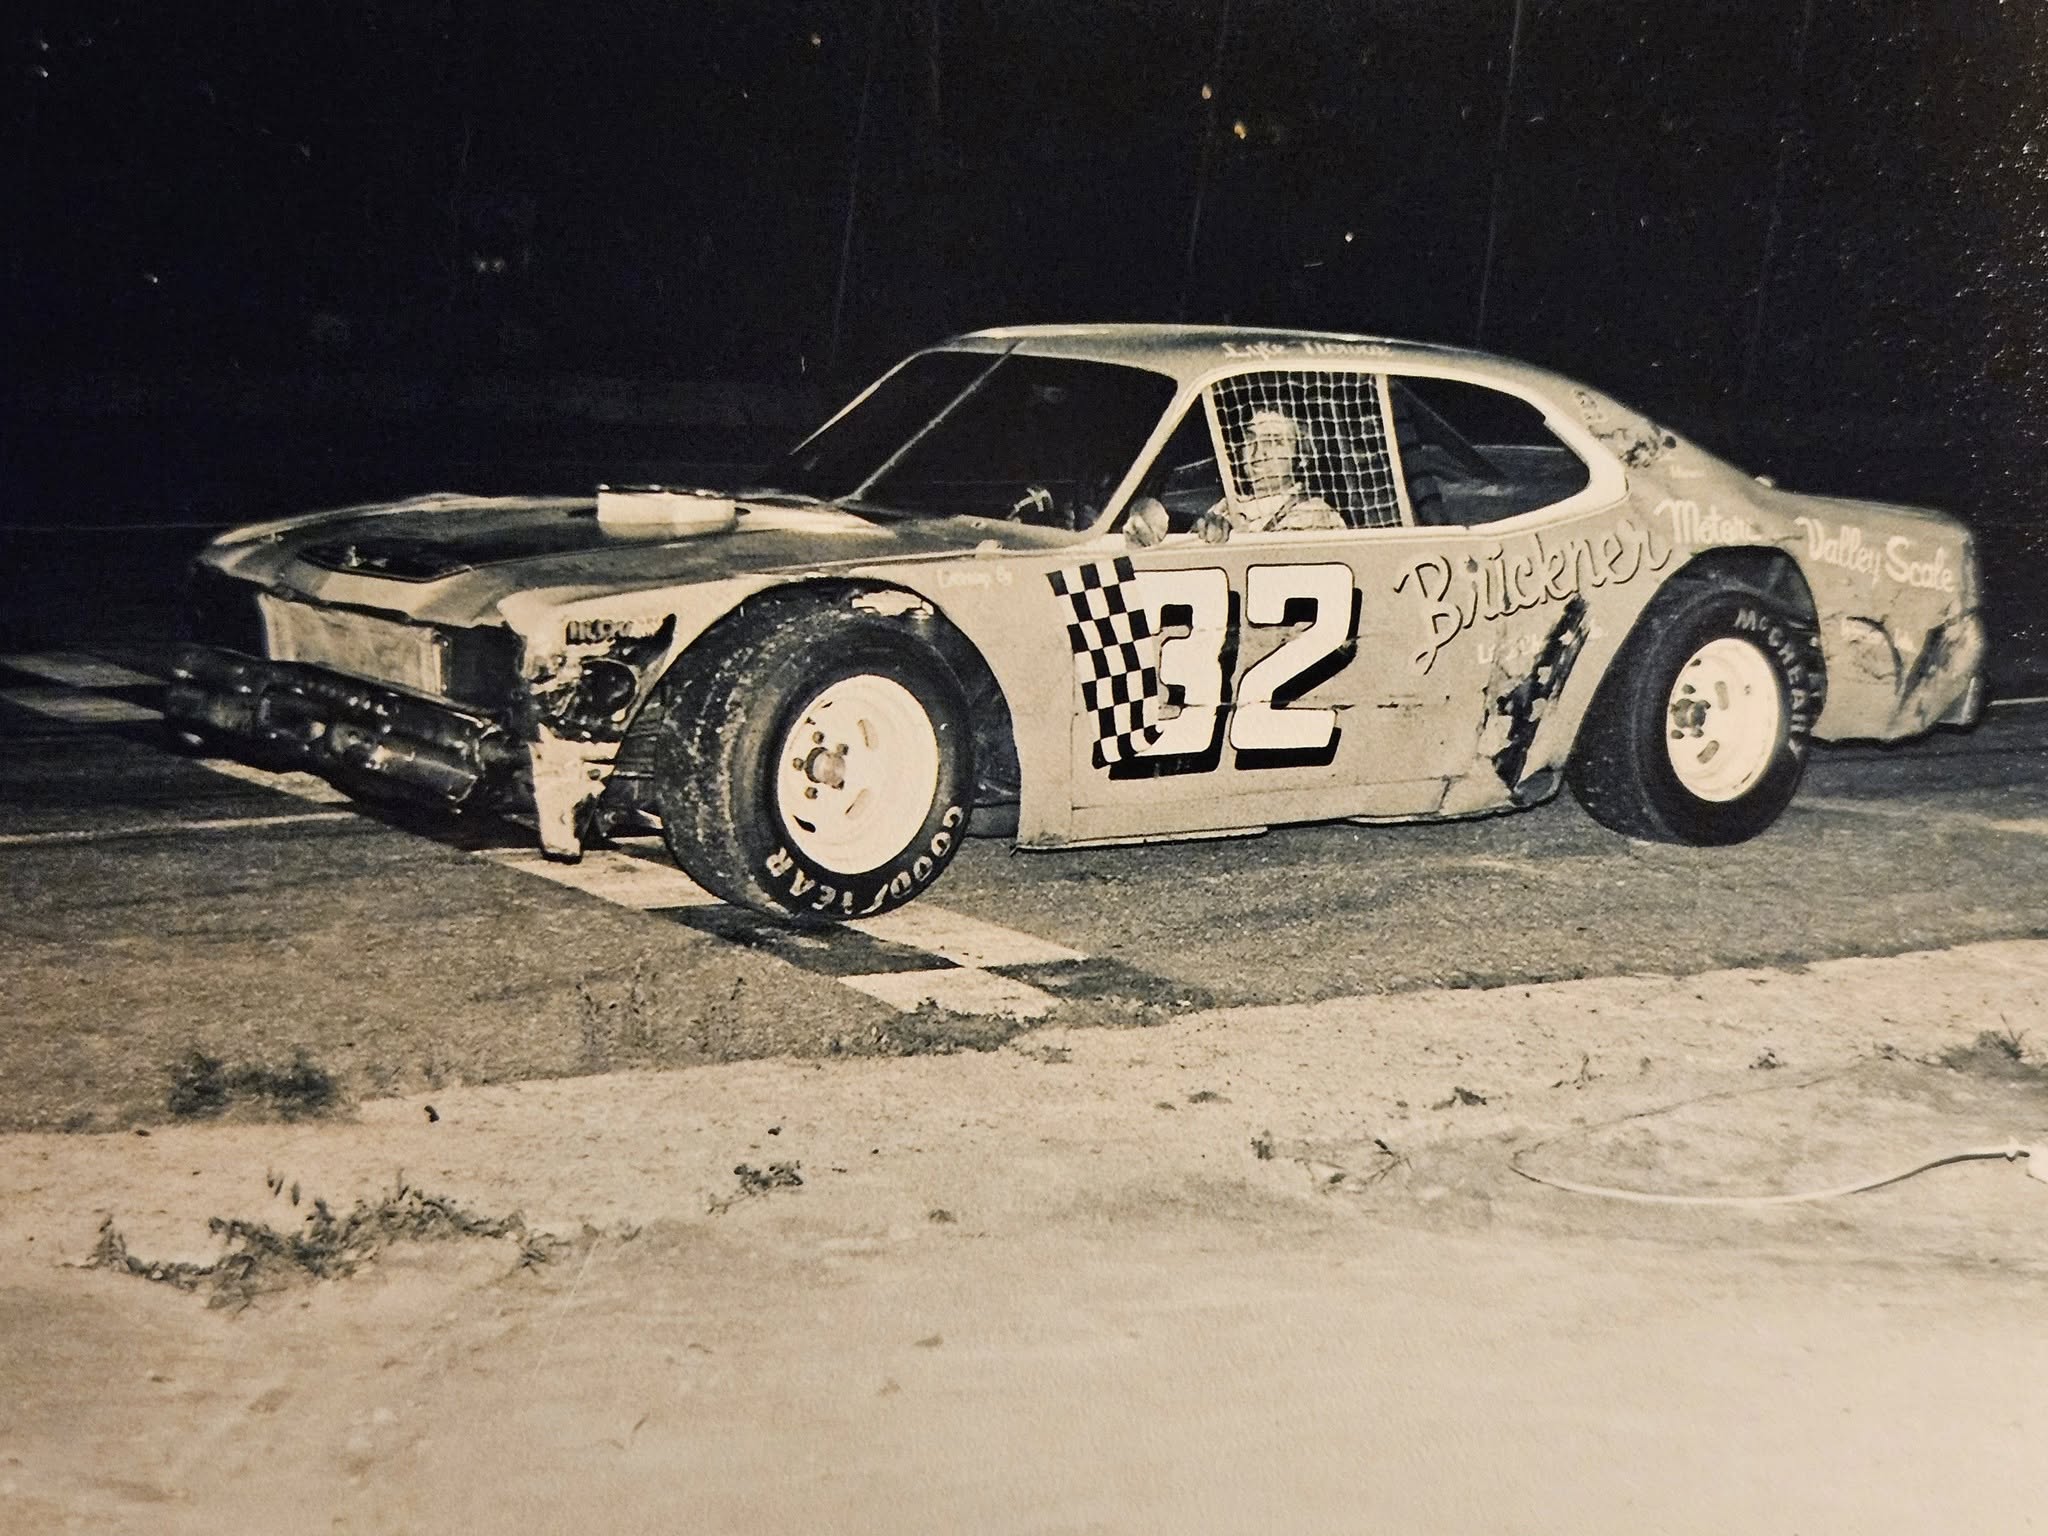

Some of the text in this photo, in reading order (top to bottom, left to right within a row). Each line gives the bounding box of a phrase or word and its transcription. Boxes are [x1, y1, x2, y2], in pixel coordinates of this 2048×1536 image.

[1793, 516, 1956, 593] Valley Scale
[1110, 562, 1363, 780] 32
